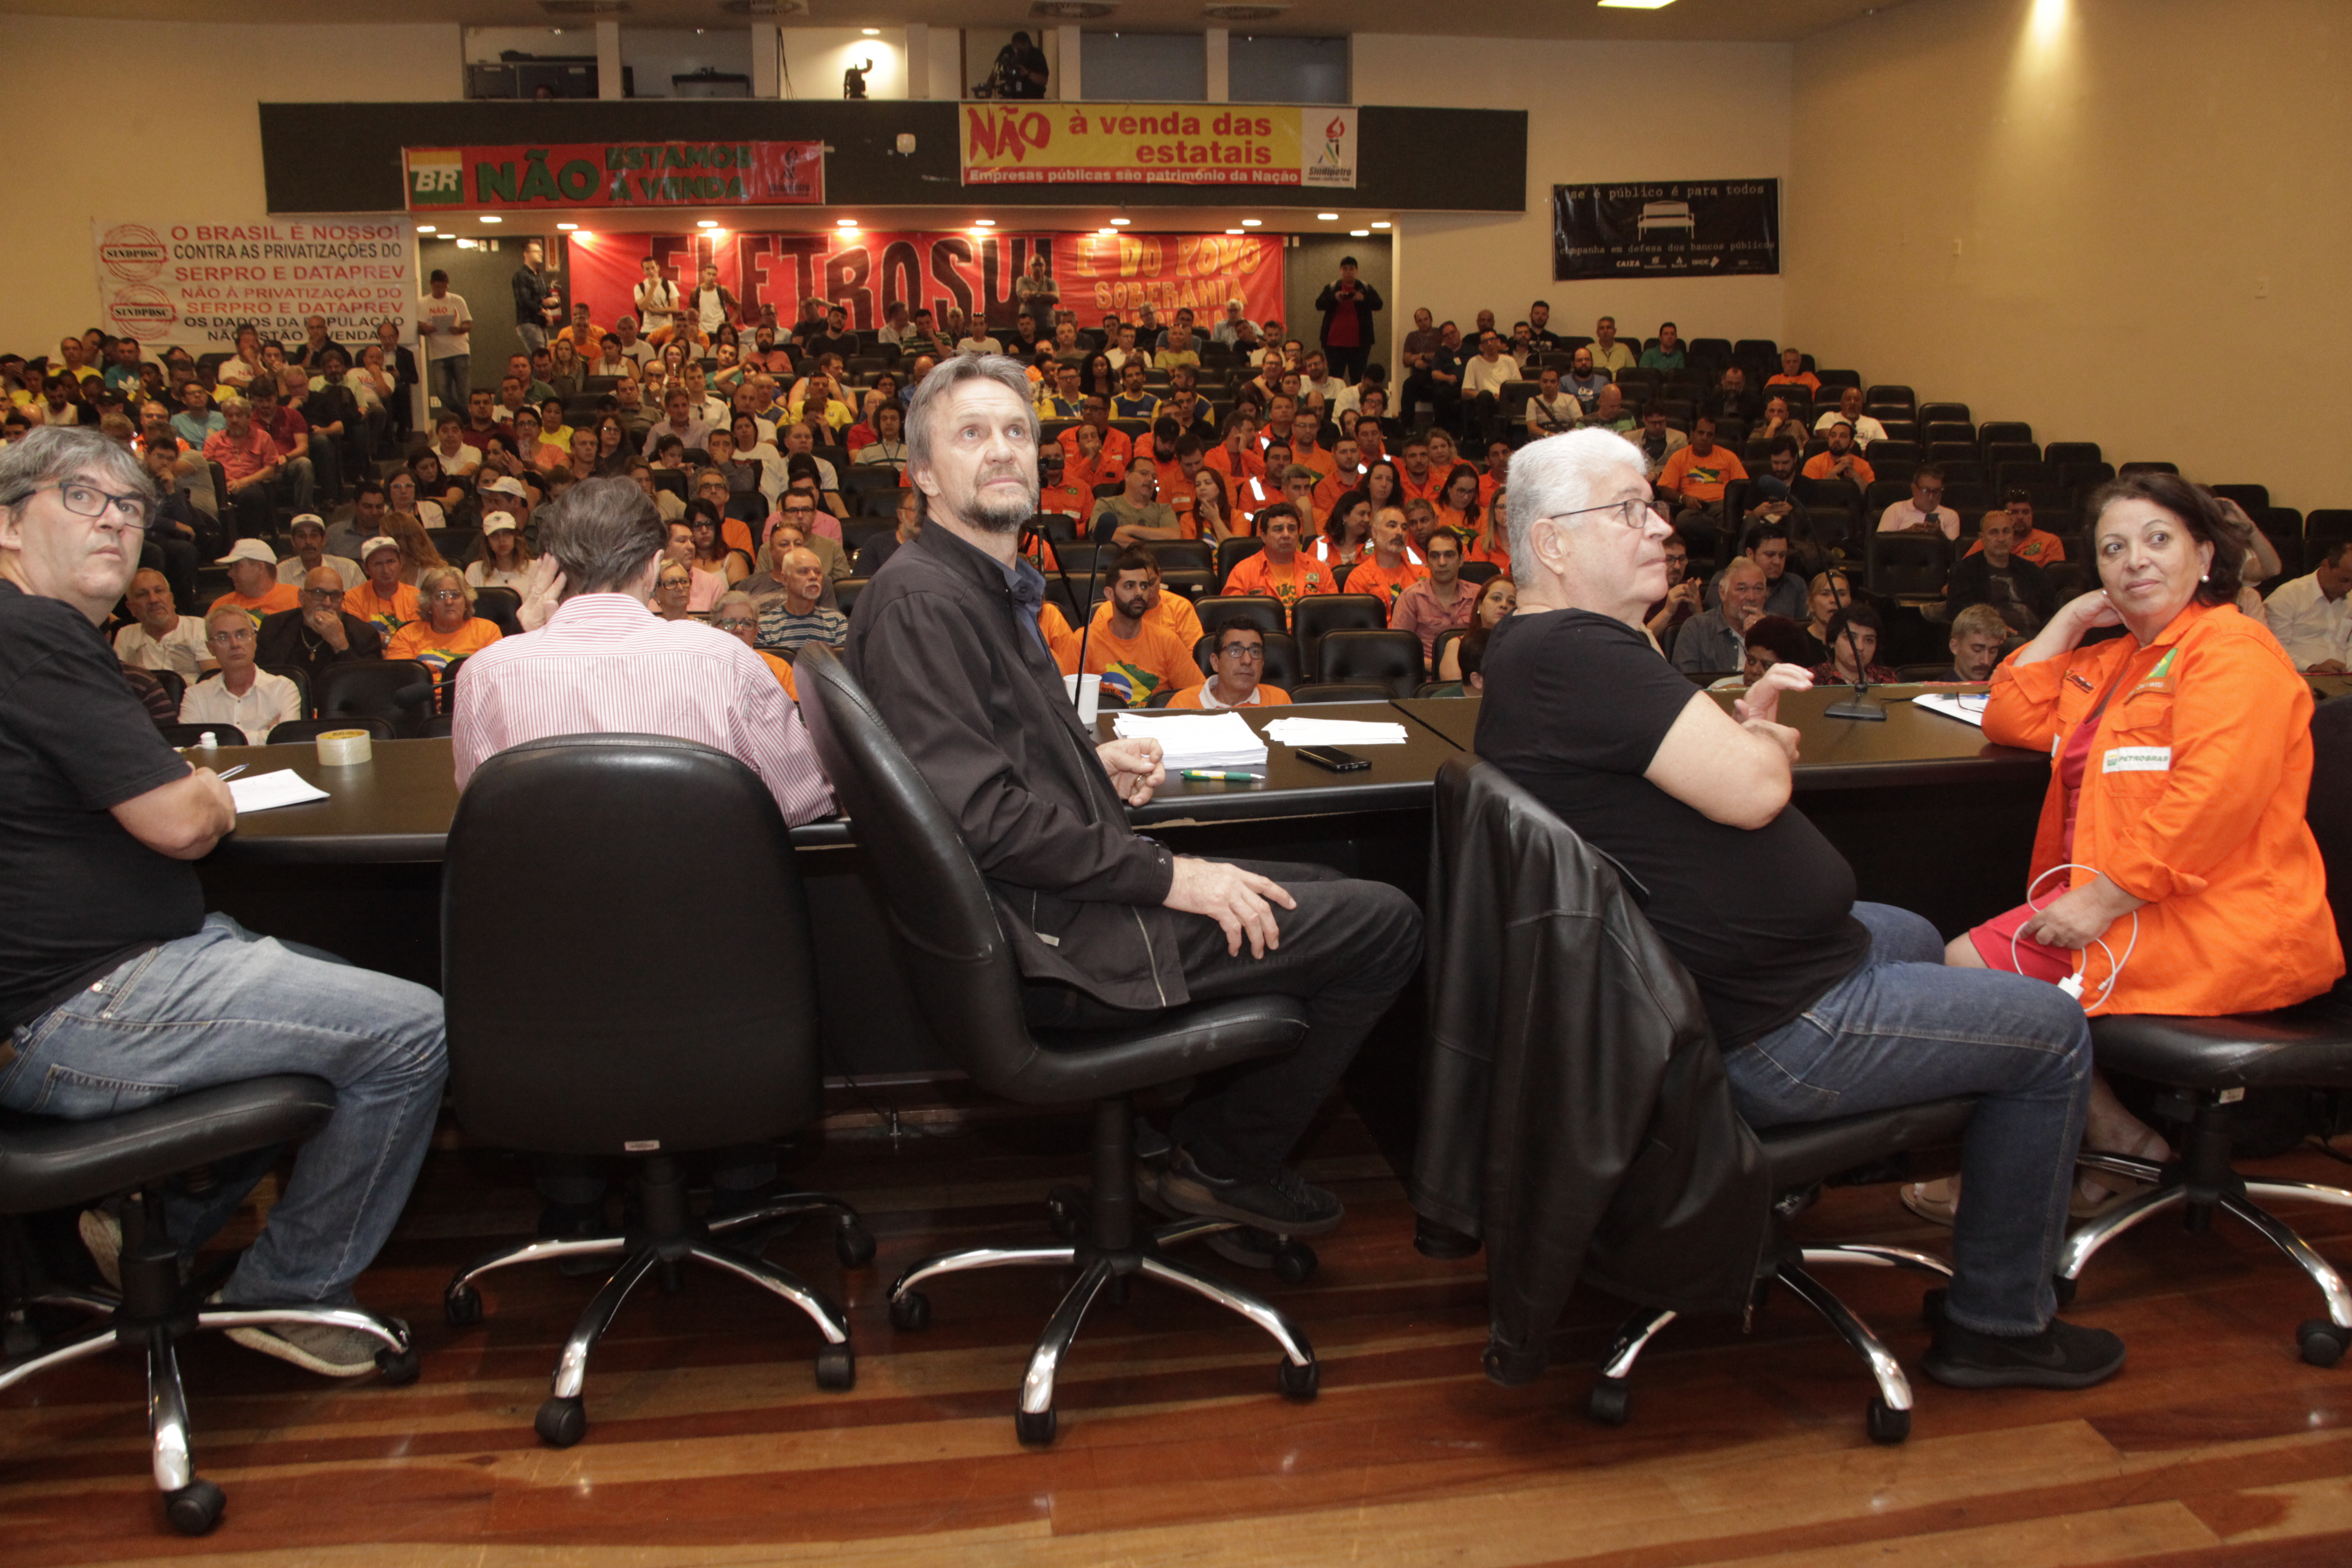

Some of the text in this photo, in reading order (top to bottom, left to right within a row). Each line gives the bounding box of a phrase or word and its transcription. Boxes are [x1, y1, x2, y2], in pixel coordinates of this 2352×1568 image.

[967, 106, 1271, 162] NÃO à venda das
[606, 146, 753, 170] ESTAMOS
[1136, 140, 1271, 165] estatais
[415, 169, 458, 191] BR
[476, 149, 600, 203] NÃO
[609, 171, 748, 201] À VENDA
[970, 168, 1298, 184] Empresas públicas são patrimônio da Nação
[1609, 186, 1663, 201] público
[1687, 187, 1718, 199] para
[1727, 183, 1764, 195] todos
[171, 226, 188, 241] O
[197, 225, 284, 241] BRASIL
[312, 224, 400, 240] NOSSO!
[174, 240, 402, 261] CONTRA AS PRIVATIZAÇÕES DO
[1119, 236, 1162, 277] DO
[175, 265, 405, 281] SERPRO E DATAPREV
[181, 285, 221, 299] NÃO
[244, 286, 371, 300] PRIVATIZAÇÃO
[377, 288, 402, 299] DO
[1094, 278, 1248, 310] SOBERANIA
[187, 302, 403, 314] SERPRO E DATAPREV
[184, 317, 208, 327] OS
[213, 317, 271, 328] DADOS
[276, 317, 299, 327] DA
